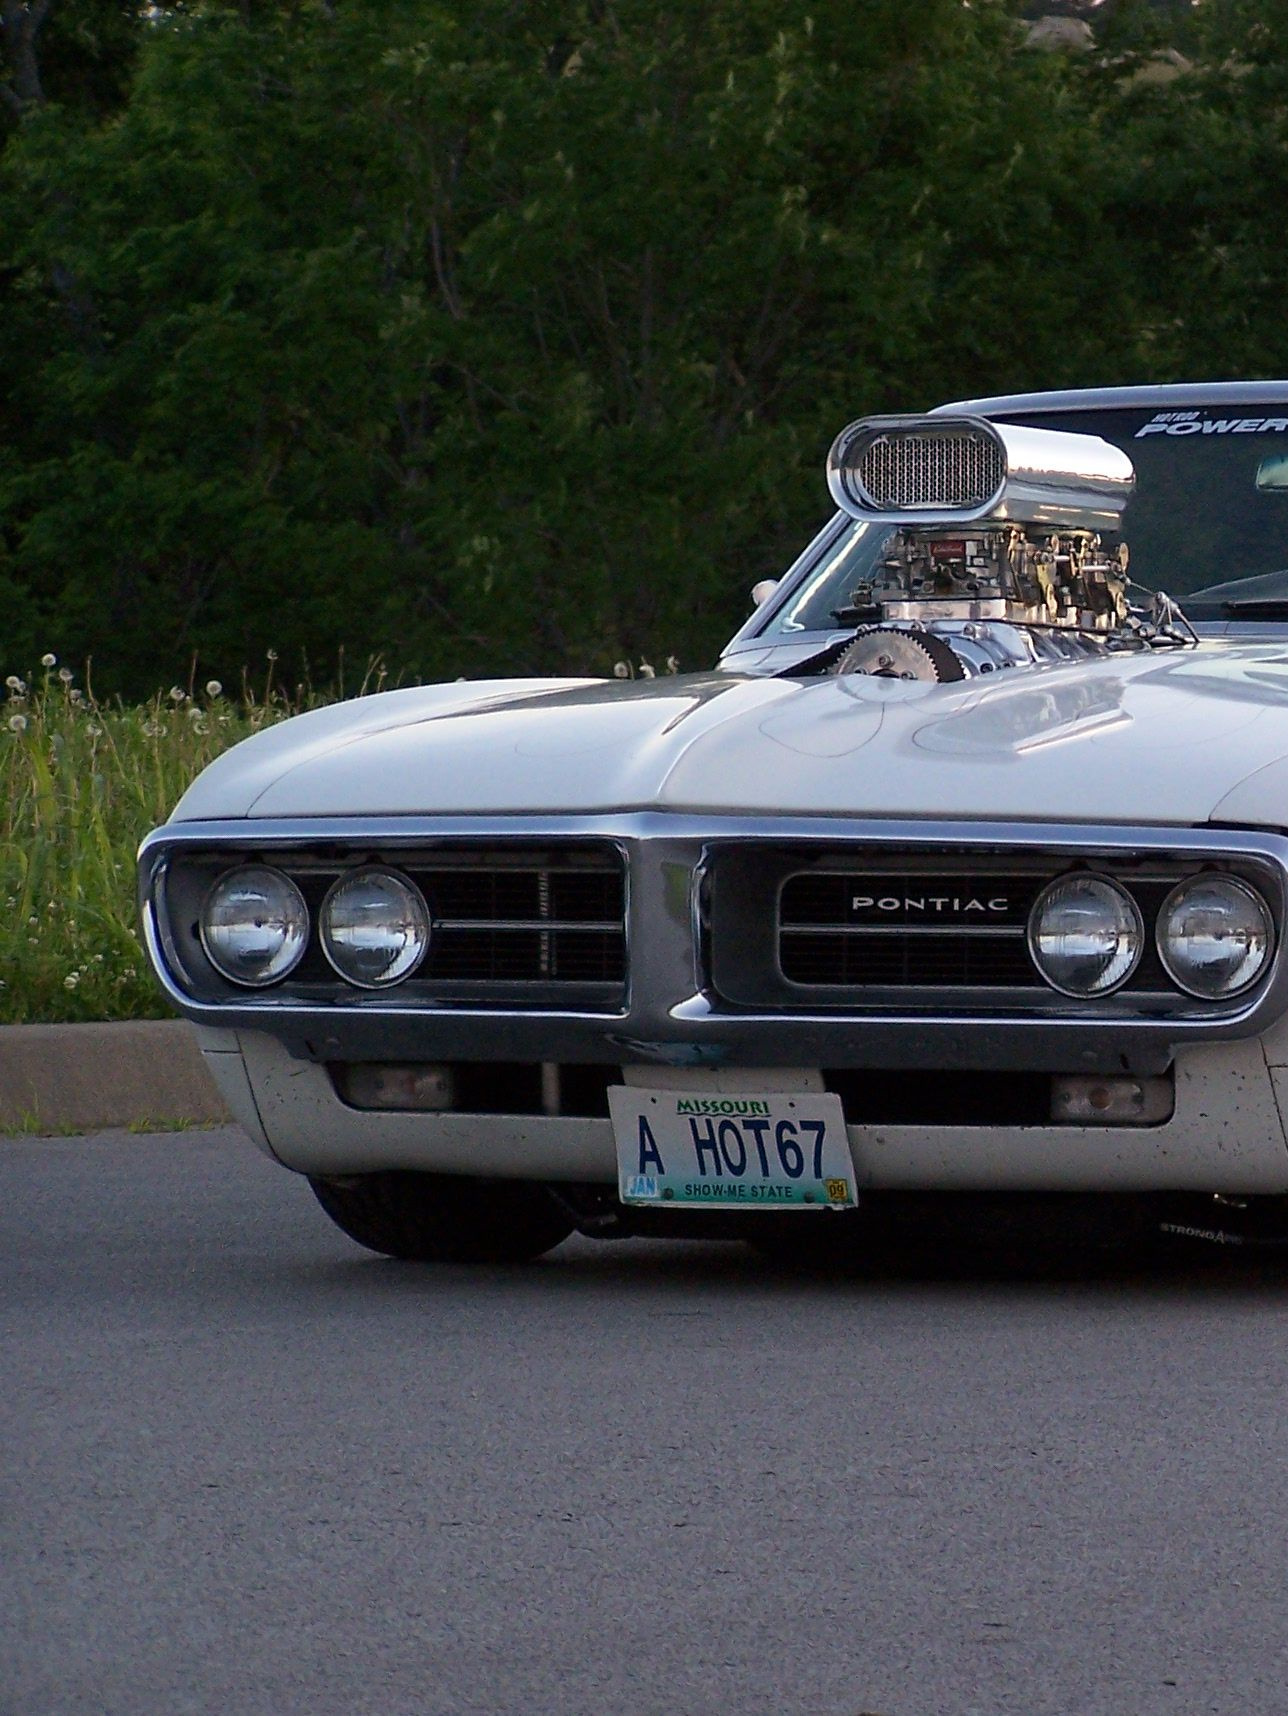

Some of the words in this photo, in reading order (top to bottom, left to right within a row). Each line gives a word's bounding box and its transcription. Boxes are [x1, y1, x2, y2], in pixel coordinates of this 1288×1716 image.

[852, 897, 1008, 911] PONTIAC
[676, 1099, 770, 1114] MISSOURI
[638, 1115, 665, 1175] A
[689, 1117, 826, 1179] HOT67
[629, 1177, 657, 1196] JAN
[684, 1184, 746, 1198] SHOW-ME
[750, 1185, 793, 1198] STATE
[829, 1185, 845, 1199] 09
